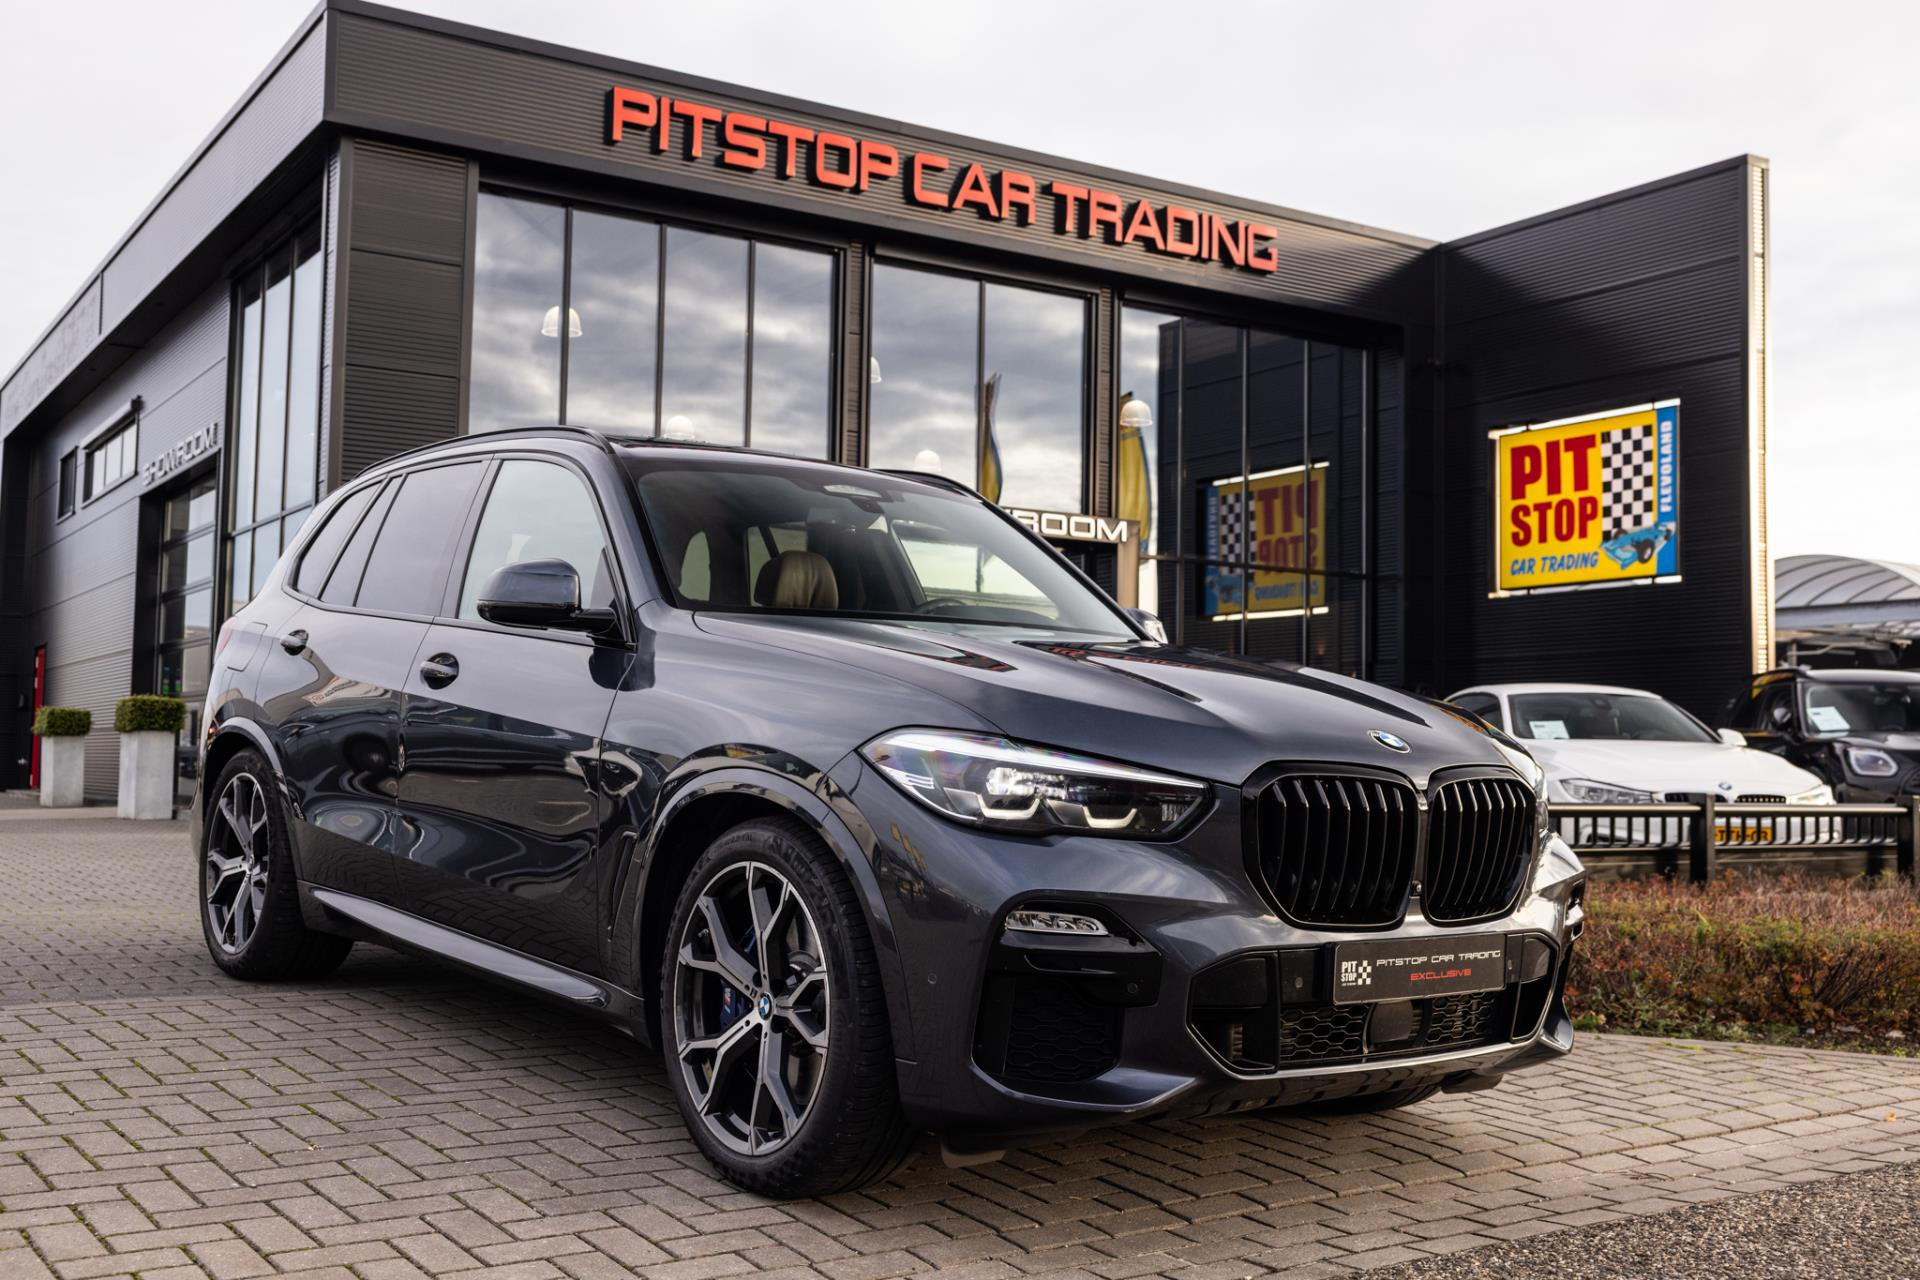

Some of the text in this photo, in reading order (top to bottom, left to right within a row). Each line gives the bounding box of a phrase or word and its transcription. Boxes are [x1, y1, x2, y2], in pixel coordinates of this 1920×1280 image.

[611, 86, 1279, 272] PITSTOP CAR TRADING
[1510, 434, 1597, 500] PIT
[1660, 420, 1673, 513] FLEVOLAND
[1510, 496, 1599, 547] STOP
[1510, 551, 1599, 576] CAR TRADING
[1341, 961, 1358, 973] PIT
[1376, 950, 1501, 967] PITSTOP CAR TRADING
[1341, 972, 1357, 982] STOP
[1410, 968, 1472, 981] EXCLUSIVE
